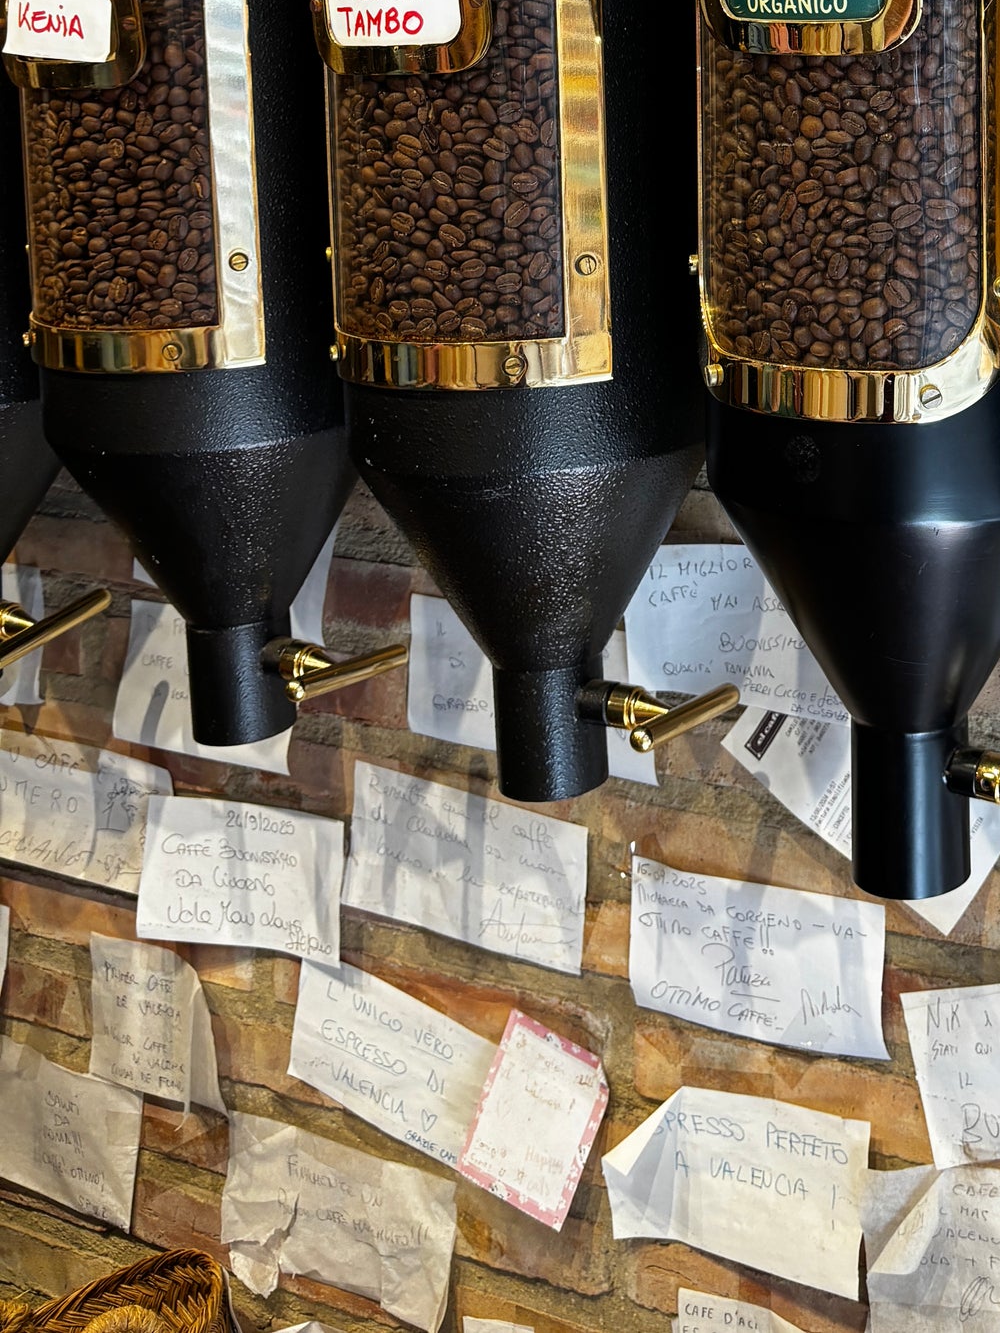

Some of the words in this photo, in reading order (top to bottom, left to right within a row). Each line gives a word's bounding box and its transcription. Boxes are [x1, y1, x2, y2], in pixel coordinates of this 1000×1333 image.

[337, 6, 424, 37] TAMBO
[650, 564, 667, 580] IL
[679, 558, 753, 577] MIGLIOR
[321, 1019, 407, 1076] ESPRESSO
[427, 1069, 445, 1094] DI
[414, 1028, 454, 1060] VERO
[329, 1063, 408, 1123] VALENCIA
[959, 1072, 973, 1089] IL
[54, 1114, 70, 1126] DA
[675, 1150, 688, 1177] A
[710, 1157, 808, 1200] VALENCIA
[685, 1303, 714, 1319] CAFE
